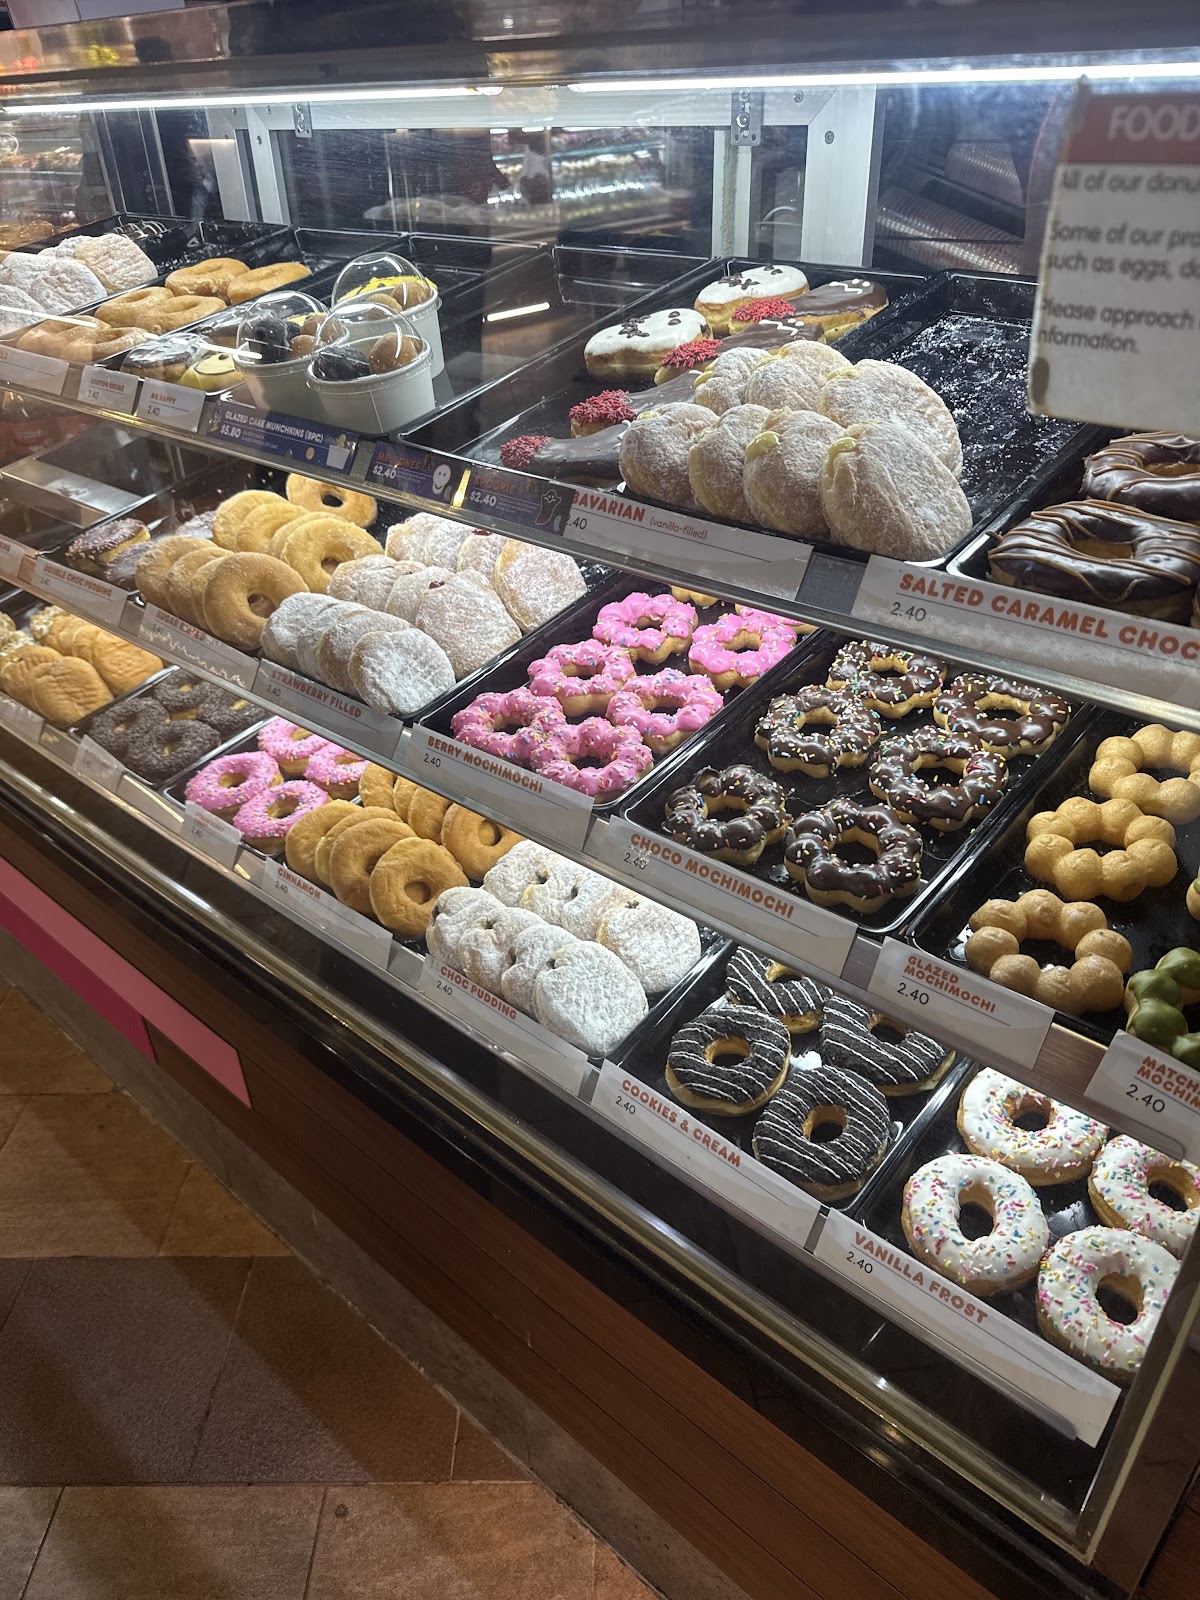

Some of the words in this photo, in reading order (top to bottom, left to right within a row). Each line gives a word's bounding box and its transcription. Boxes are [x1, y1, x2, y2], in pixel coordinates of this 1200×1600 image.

[1107, 103, 1200, 143] FOOD
[1084, 168, 1106, 192] of
[1108, 174, 1142, 192] our
[1105, 220, 1128, 245] of
[1129, 228, 1164, 246] our
[1091, 256, 1115, 273] as
[1100, 306, 1195, 330] approach
[87, 389, 100, 400] 2.40
[161, 394, 177, 405] HAPPY
[147, 405, 161, 417] 2.40
[220, 422, 241, 438] $5.80
[225, 410, 248, 424] GLAZED
[249, 416, 266, 428] CAKE
[265, 420, 305, 439] MUNCHKINS
[372, 463, 397, 480] $2.40
[469, 489, 498, 508] $2.40
[566, 516, 588, 530] .40
[573, 490, 645, 522] BAVARIAN
[649, 517, 709, 540] (vanilla-filled)
[889, 601, 927, 623] 2.40
[900, 573, 984, 607] SALTED
[991, 595, 1108, 639] CARAMEL
[1118, 626, 1200, 660] CHOC
[266, 684, 281, 698] 2.40
[271, 669, 330, 704] STRAWBERRY
[329, 695, 362, 719] FILLED
[423, 753, 442, 769] 2.40
[427, 735, 462, 762] BERRY
[463, 751, 544, 794] MOCHIMOCHI
[623, 852, 648, 871] 2.40
[275, 880, 289, 894] 2.40
[277, 867, 322, 900] CINNAMON
[630, 833, 682, 865] CHOCO
[684, 858, 795, 919] MOCHIMOCHI
[908, 955, 960, 984] GLAZED
[436, 980, 454, 996] 2.40
[440, 965, 470, 990] CHOC
[470, 984, 518, 1020] PUDDING
[896, 982, 930, 1006] 2.40
[903, 964, 997, 1014] MOCHIMOCHI
[1141, 1055, 1200, 1096] MATCH
[615, 1095, 637, 1116] 2.40
[1125, 1083, 1166, 1113] 2.40
[622, 1079, 679, 1124] COOKIES
[679, 1119, 690, 1133] &
[692, 1128, 742, 1168] CREAM
[845, 1251, 874, 1274] 2.40
[854, 1231, 925, 1286] VANILLA
[928, 1280, 990, 1324] FROST
